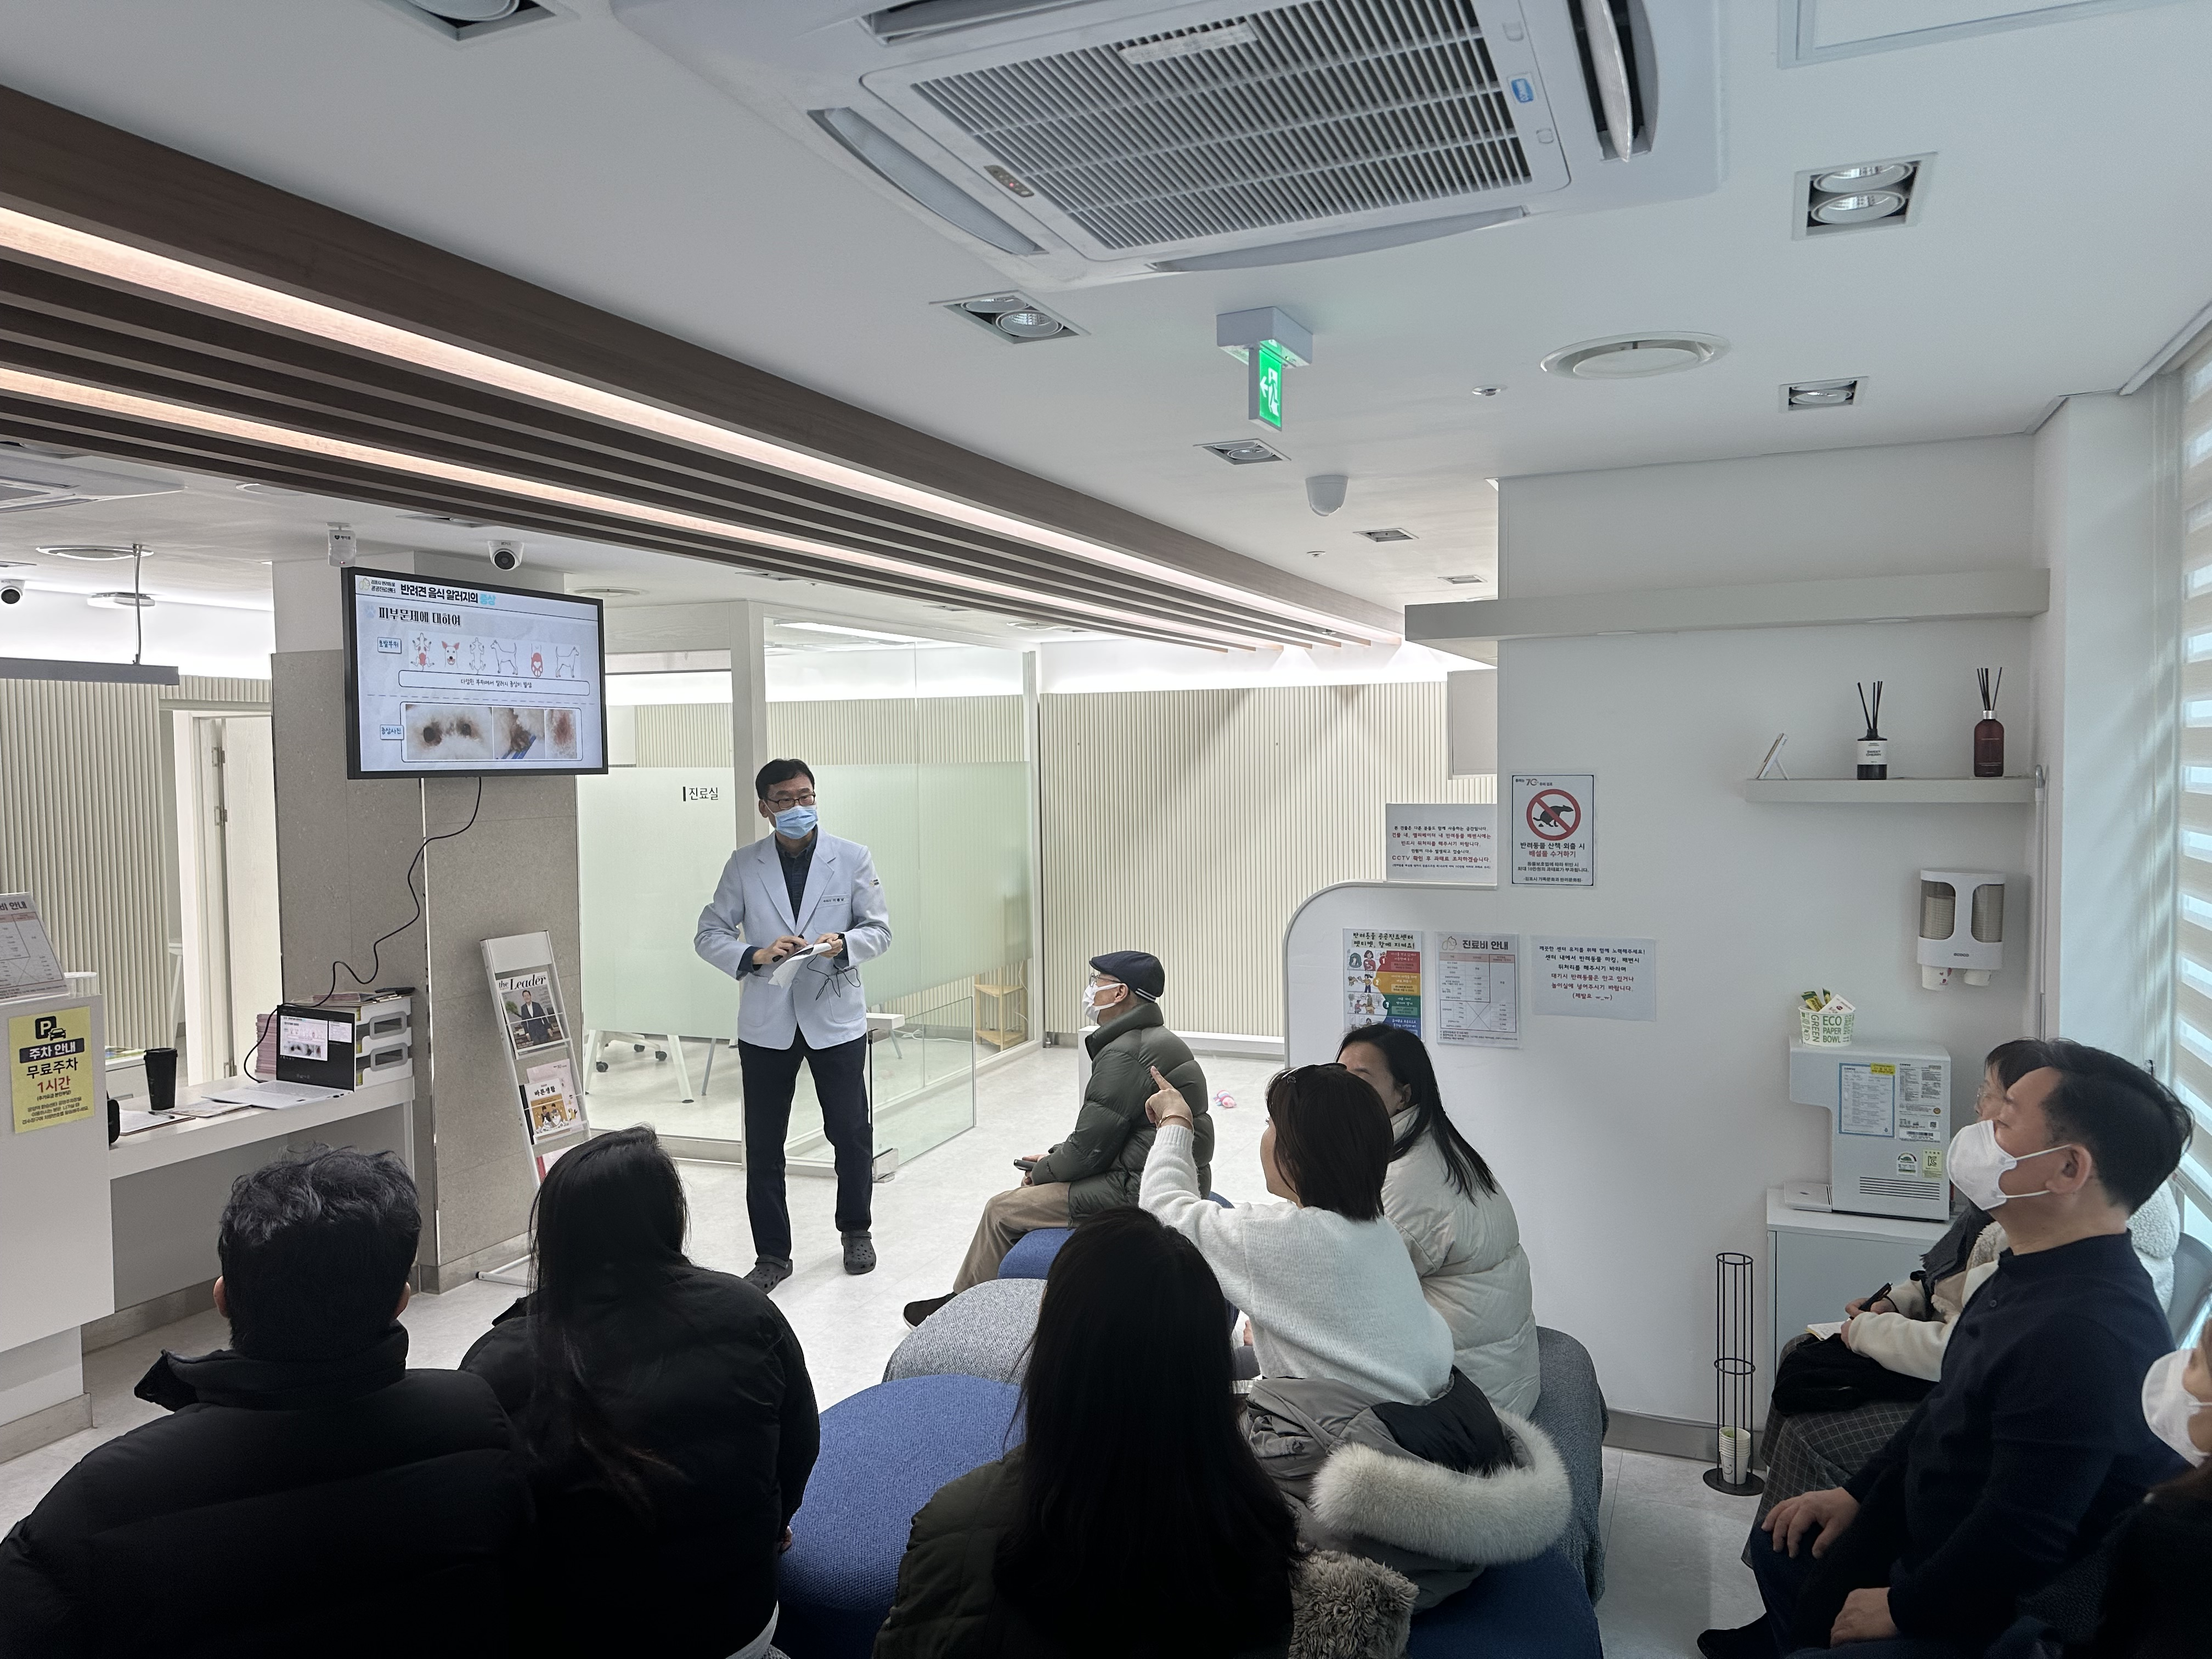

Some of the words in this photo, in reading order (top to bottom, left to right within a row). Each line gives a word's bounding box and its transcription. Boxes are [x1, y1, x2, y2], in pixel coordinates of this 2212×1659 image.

[400, 584, 427, 597] 반려견
[428, 588, 445, 600] 음식
[447, 589, 478, 603] 알러지의
[480, 593, 496, 606] 증상
[379, 607, 429, 623] 피부문제에
[432, 612, 461, 626] 대하여
[689, 787, 719, 801] 진료실
[9, 901, 27, 910] 안내
[1462, 940, 1488, 949] 진료비
[1491, 941, 1509, 950] 안내
[499, 980, 509, 989] the
[510, 974, 546, 990] Leader
[40, 1020, 52, 1036] P
[1811, 1014, 1820, 1042] GREEN
[1822, 1015, 1842, 1026] ECO
[29, 1046, 52, 1059] 주차
[54, 1041, 76, 1056] 안내
[26, 1057, 78, 1079] 무료주차
[37, 1075, 71, 1093] 1시간
[534, 1085, 556, 1097] 바른생활
